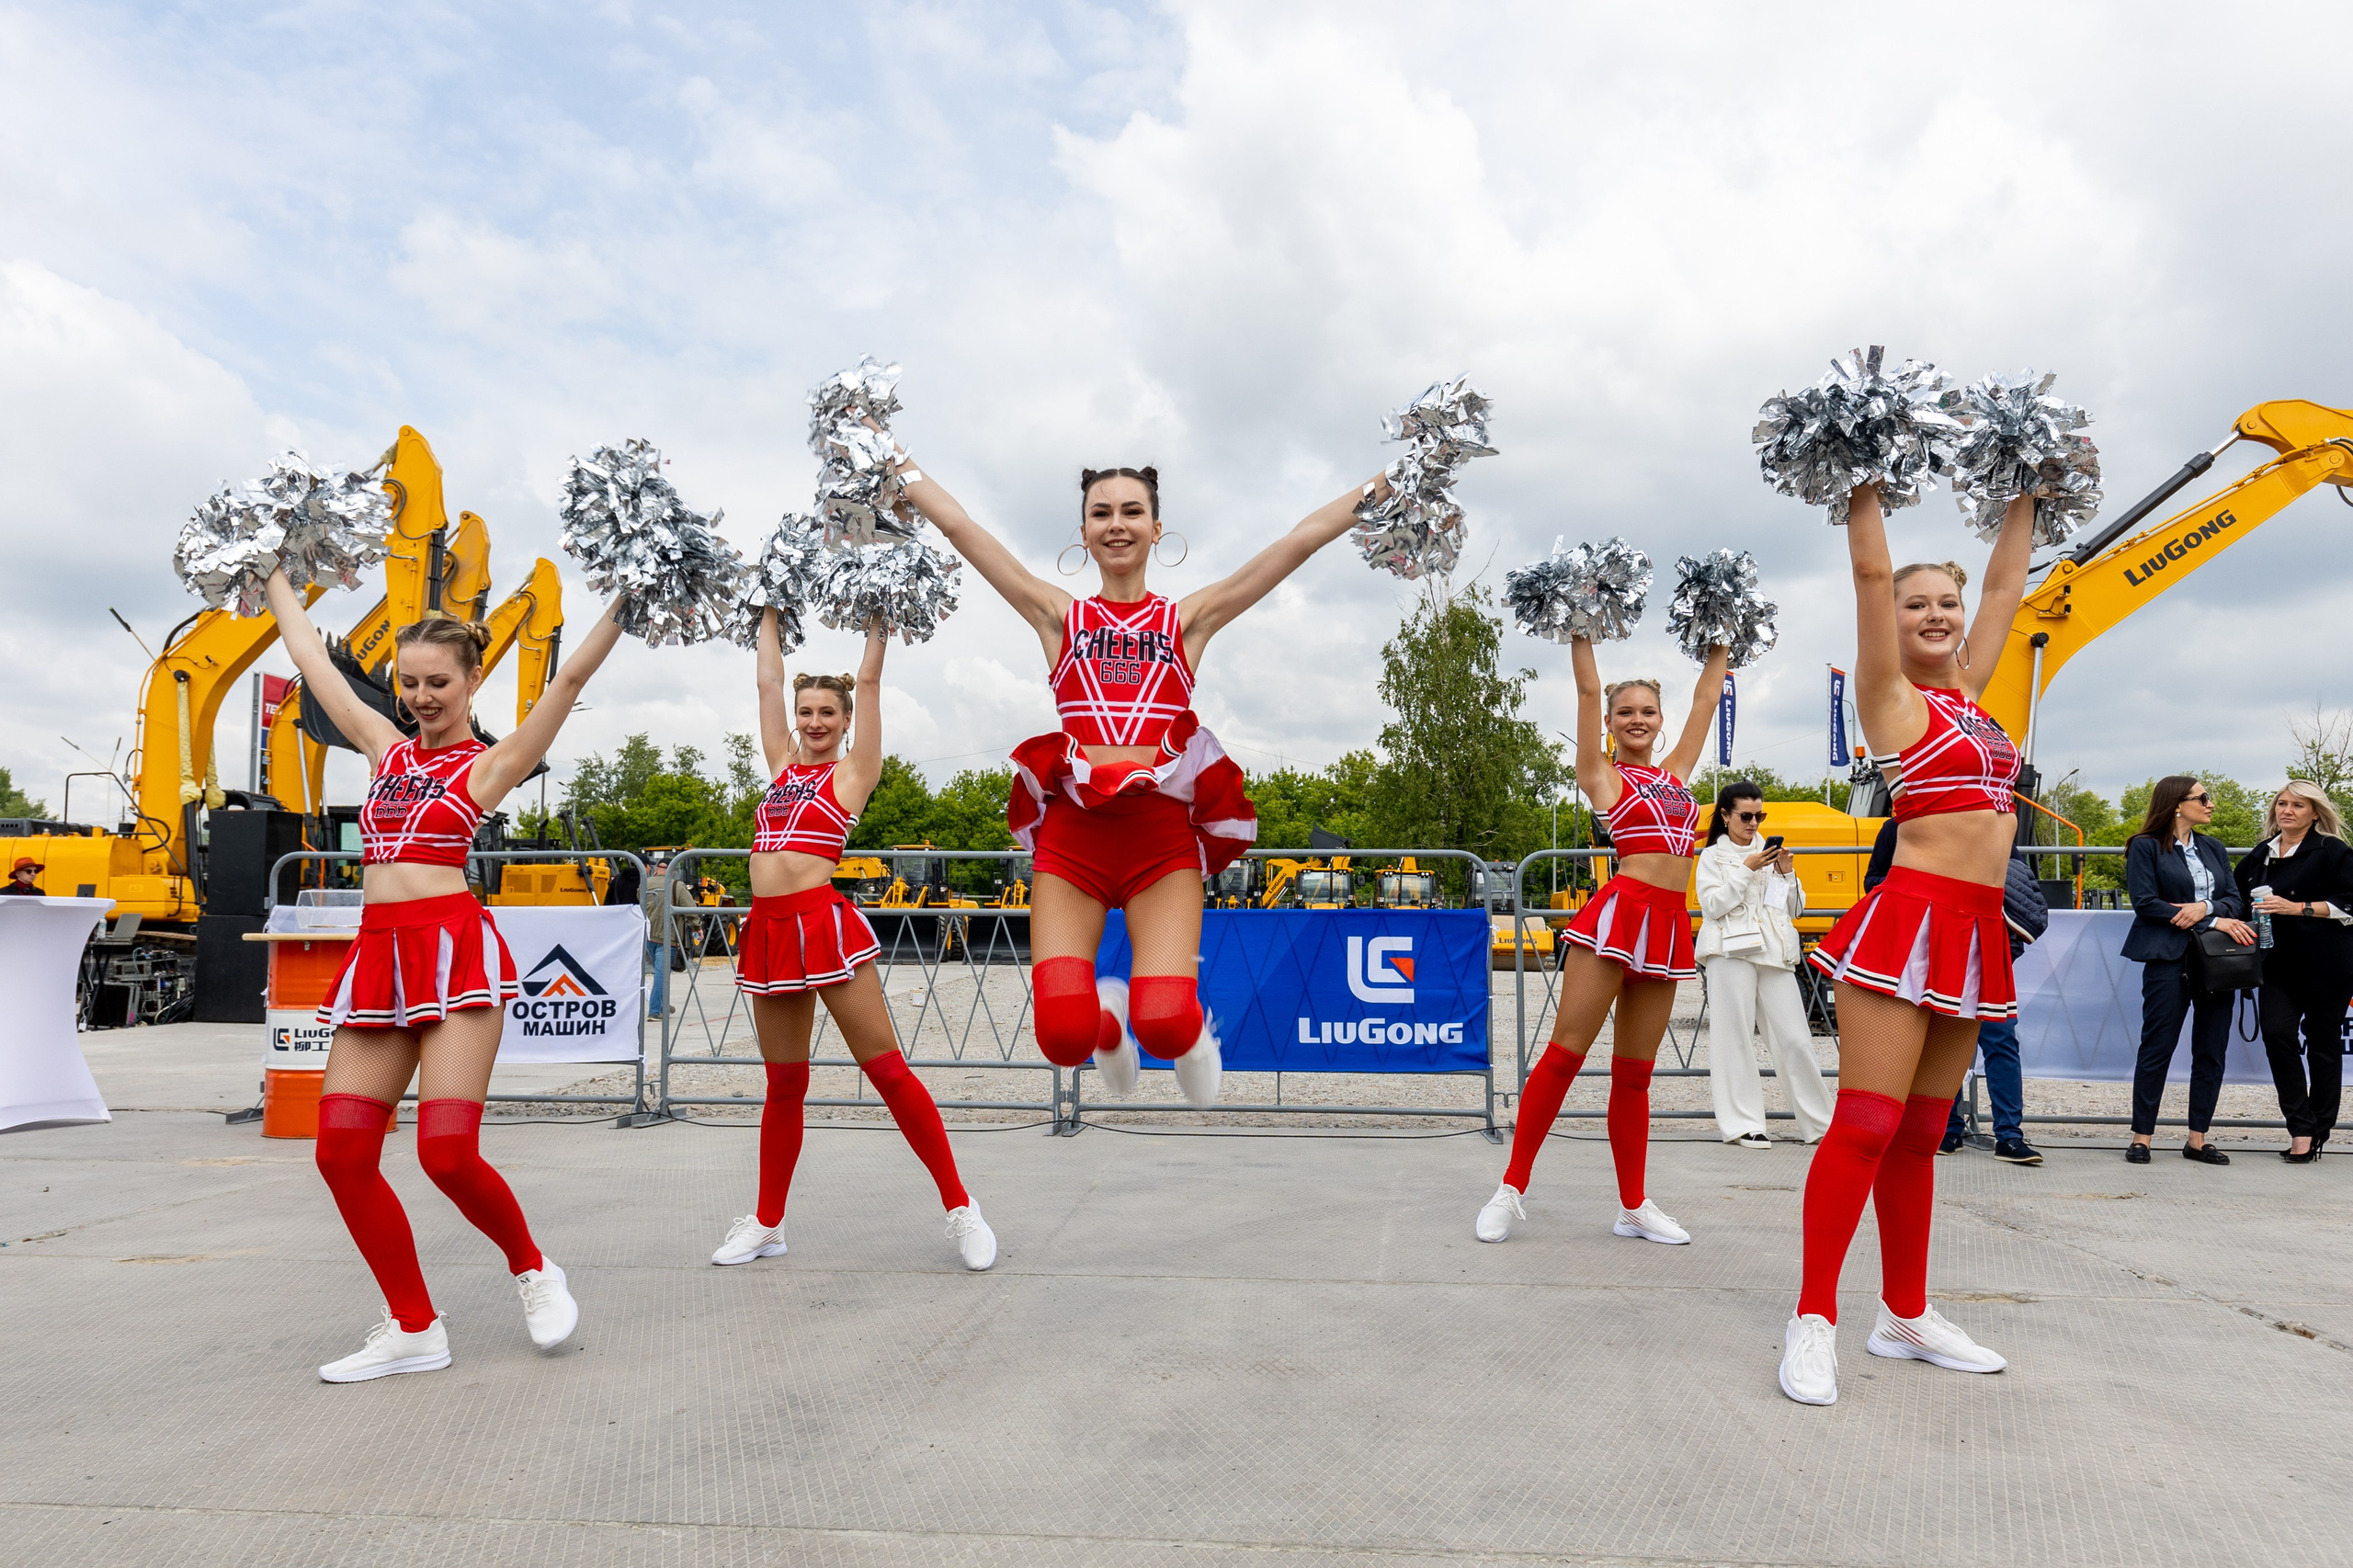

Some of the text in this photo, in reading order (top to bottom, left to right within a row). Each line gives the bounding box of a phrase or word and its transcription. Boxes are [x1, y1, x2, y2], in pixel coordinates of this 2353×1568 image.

[1073, 627, 1175, 665] CHEERS
[1100, 661, 1141, 685] 666
[368, 773, 448, 802] CHEERS
[762, 779, 817, 804] CHEERS
[1663, 801, 1688, 817] 666
[512, 999, 617, 1019] ОСТРОВ
[523, 1019, 606, 1037] МАШИН
